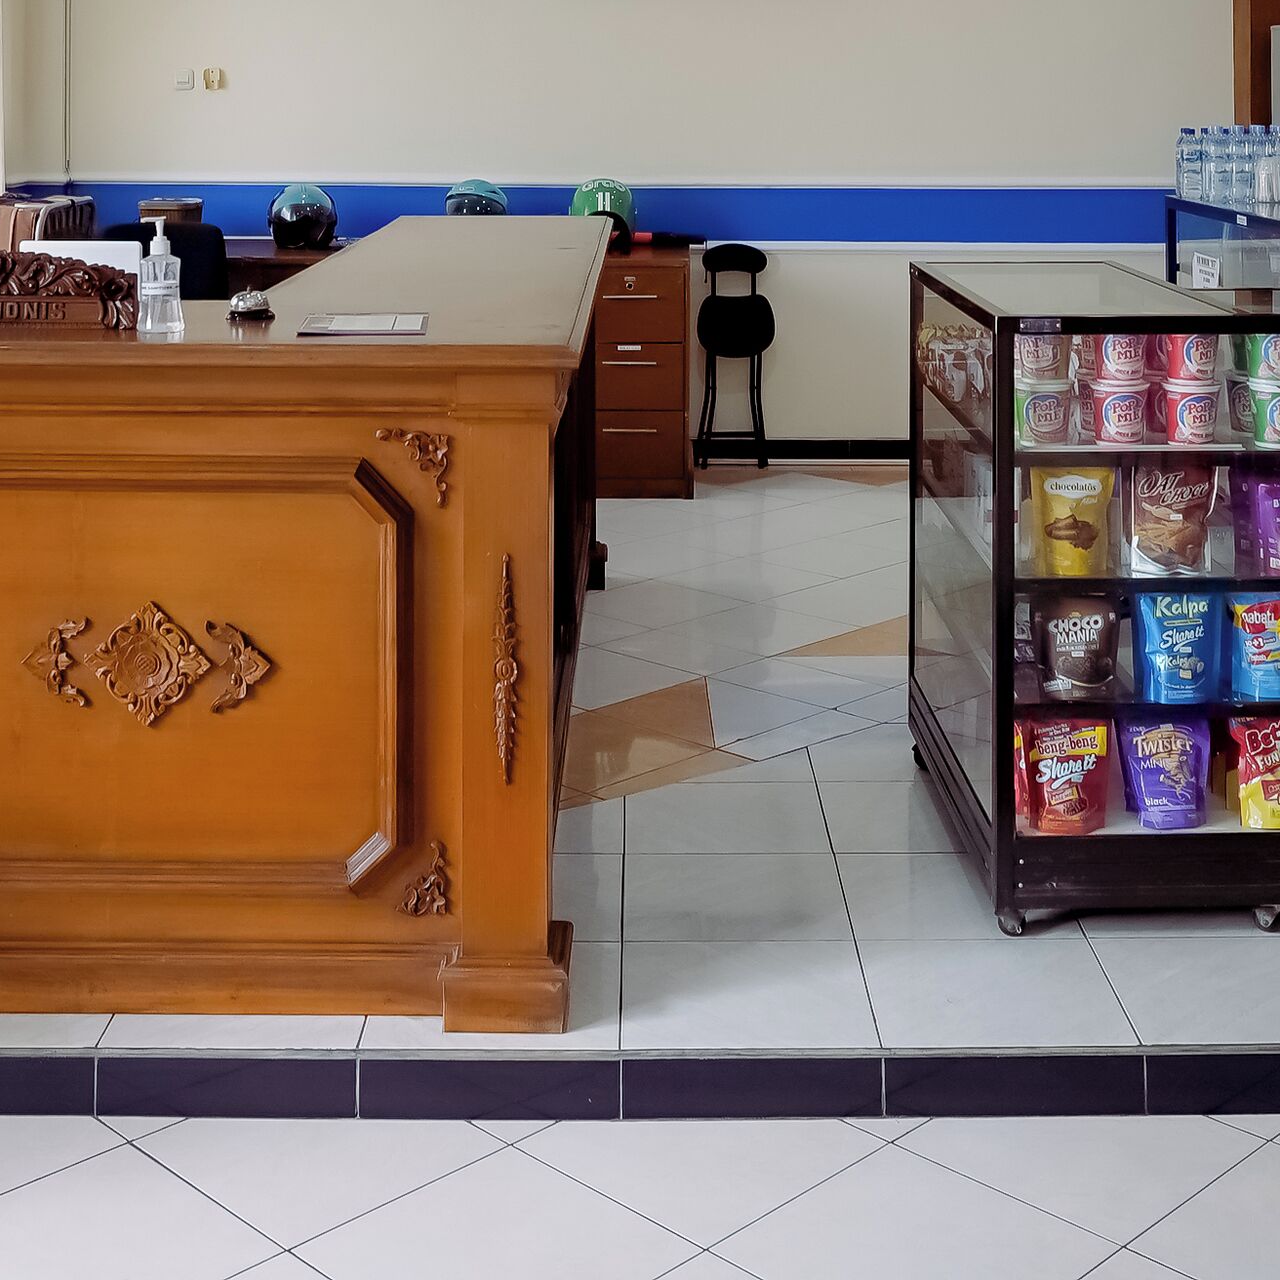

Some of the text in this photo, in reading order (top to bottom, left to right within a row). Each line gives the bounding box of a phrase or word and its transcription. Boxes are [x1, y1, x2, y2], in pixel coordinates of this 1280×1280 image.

[1113, 338, 1136, 352] POP
[1032, 400, 1056, 414] POP
[1113, 402, 1136, 416] POP
[1187, 402, 1212, 418] POP
[1155, 595, 1209, 618] Kalpa
[1048, 614, 1103, 634] CHOCO
[1056, 629, 1098, 644] MANIA
[1035, 735, 1098, 755] beng-beng
[1133, 732, 1194, 757] Twister
[1255, 750, 1280, 771] FUN
[1145, 796, 1168, 806] black
